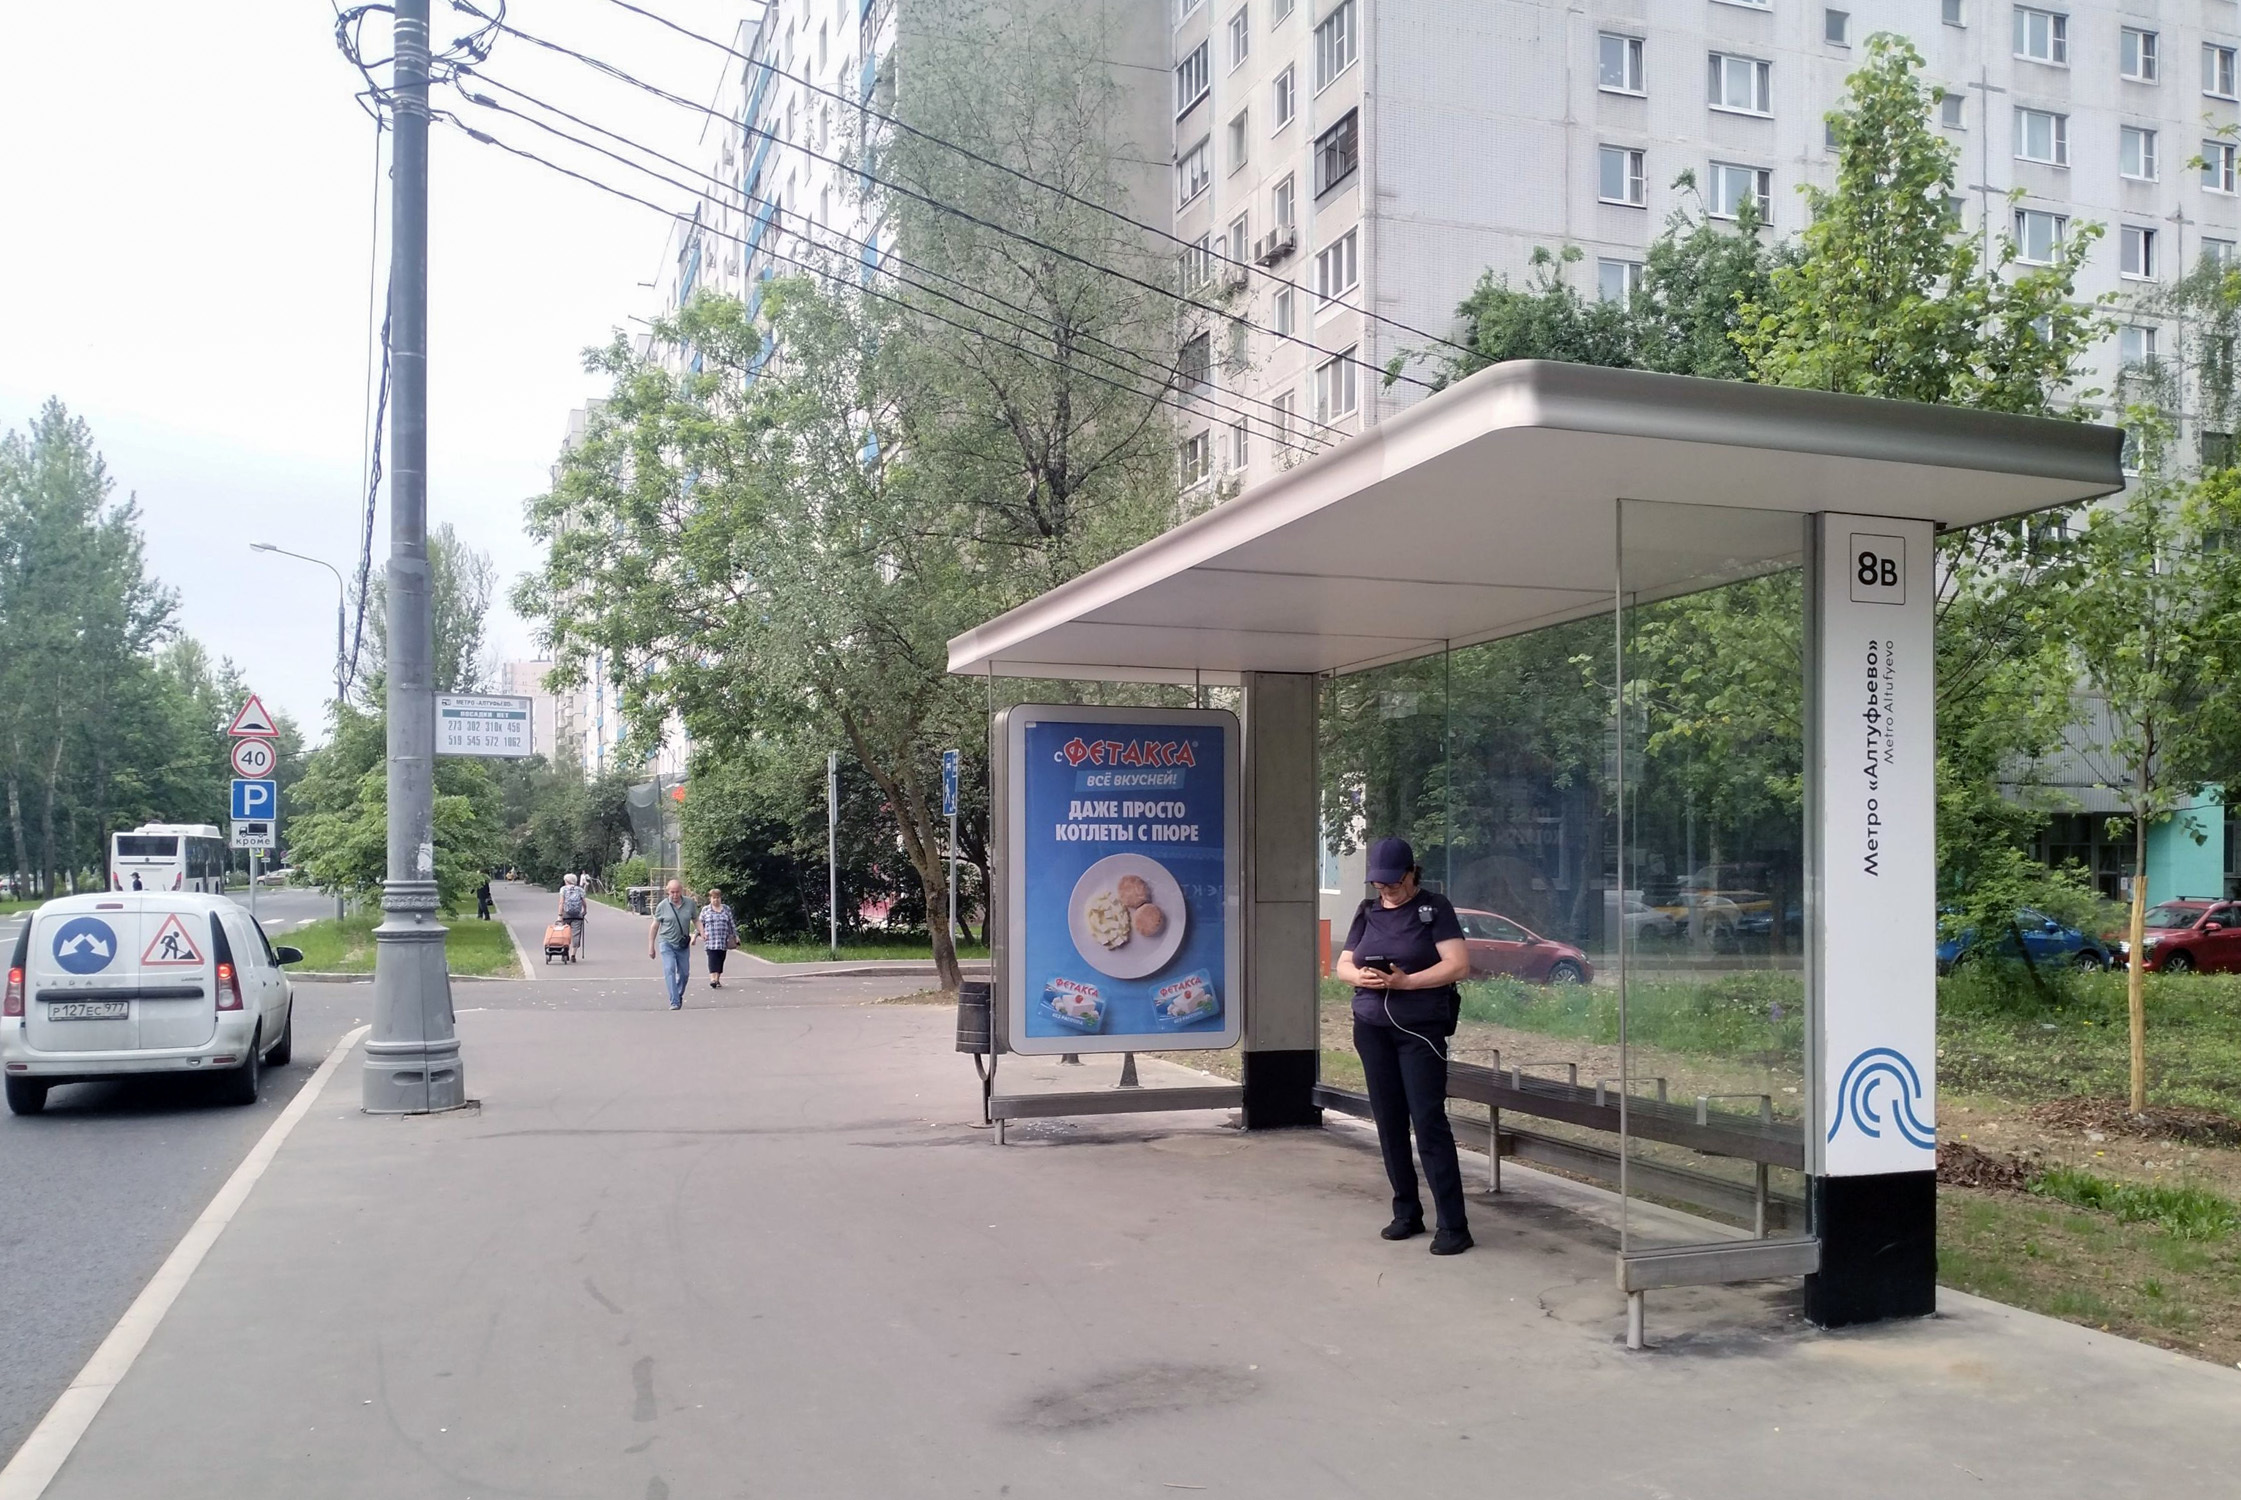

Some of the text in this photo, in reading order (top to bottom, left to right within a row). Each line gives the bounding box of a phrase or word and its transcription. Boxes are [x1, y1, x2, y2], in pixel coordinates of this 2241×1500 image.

[1883, 640, 1896, 764] Metro Altufyevo
[448, 720, 462, 731] 273
[467, 721, 480, 732] 302
[507, 722, 521, 733] 456
[448, 735, 521, 747] 519 545 572 1062
[241, 751, 266, 766] 40
[1862, 640, 1882, 877] Метро «Алтуфьево»
[1087, 770, 1178, 787] ВСЁ ВКУСНЕЙ!
[244, 784, 268, 815] P
[1068, 800, 1185, 821] ДАЖЕ ПРОСТО
[1055, 824, 1199, 841] КОТЛЕТЫ С ПЮРЕ
[236, 838, 270, 846] кроме
